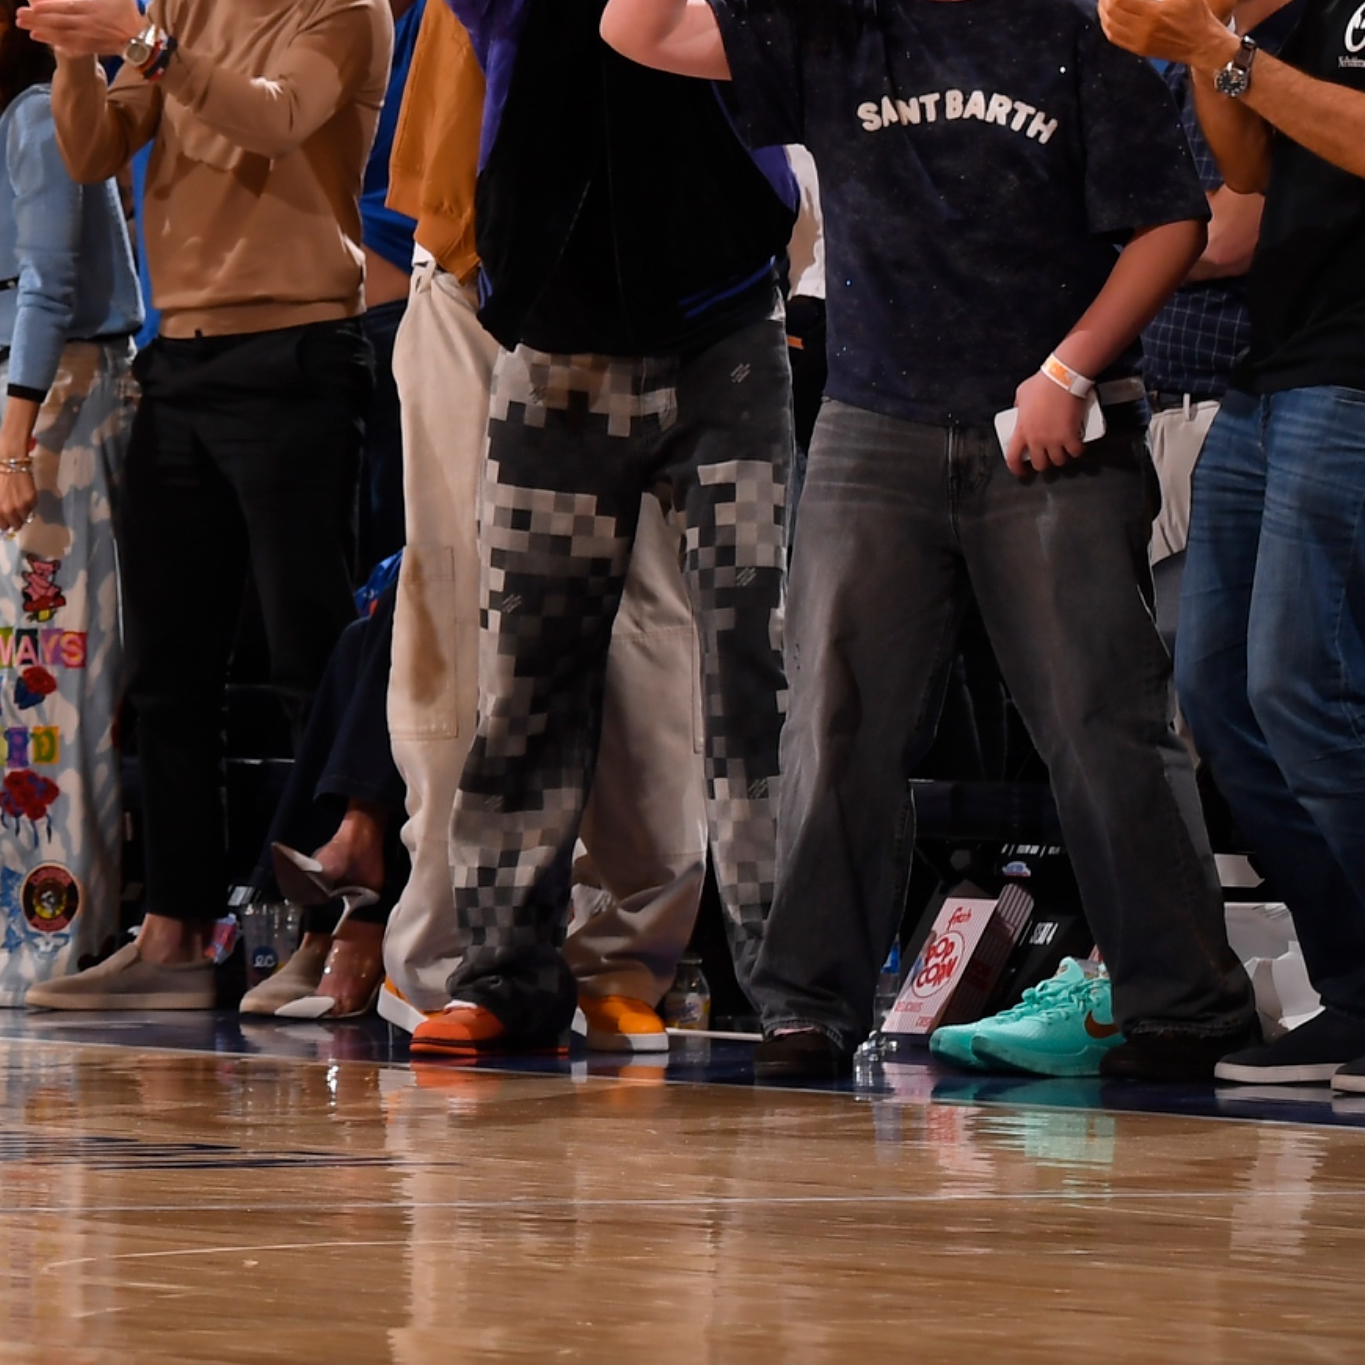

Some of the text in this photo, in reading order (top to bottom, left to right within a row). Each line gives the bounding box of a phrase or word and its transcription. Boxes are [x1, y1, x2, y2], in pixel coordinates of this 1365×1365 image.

[945, 88, 1058, 145] BARTH
[925, 937, 955, 967] POP
[916, 956, 959, 988] CORN
